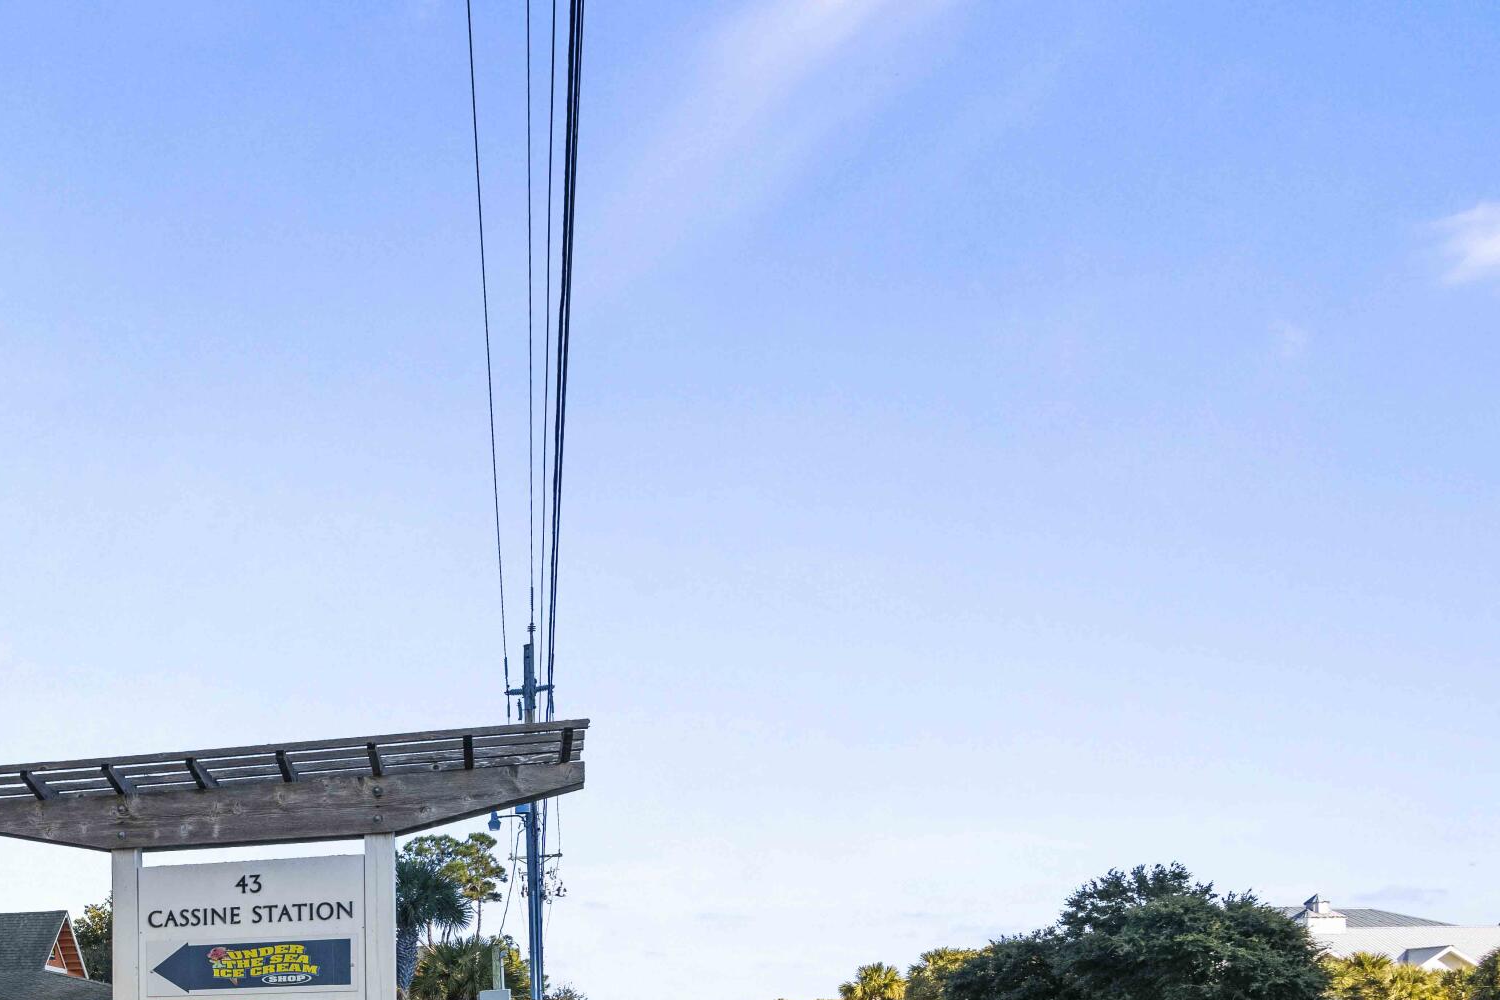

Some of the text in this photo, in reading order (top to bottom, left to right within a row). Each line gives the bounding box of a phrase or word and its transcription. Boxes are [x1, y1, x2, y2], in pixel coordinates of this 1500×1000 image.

[235, 874, 263, 894] 43
[148, 901, 354, 928] CASSINE STATION
[226, 944, 306, 960] UNDER
[222, 954, 310, 969] THE SEA
[213, 963, 319, 977] ICE CREAM
[268, 974, 307, 983] SHOP
